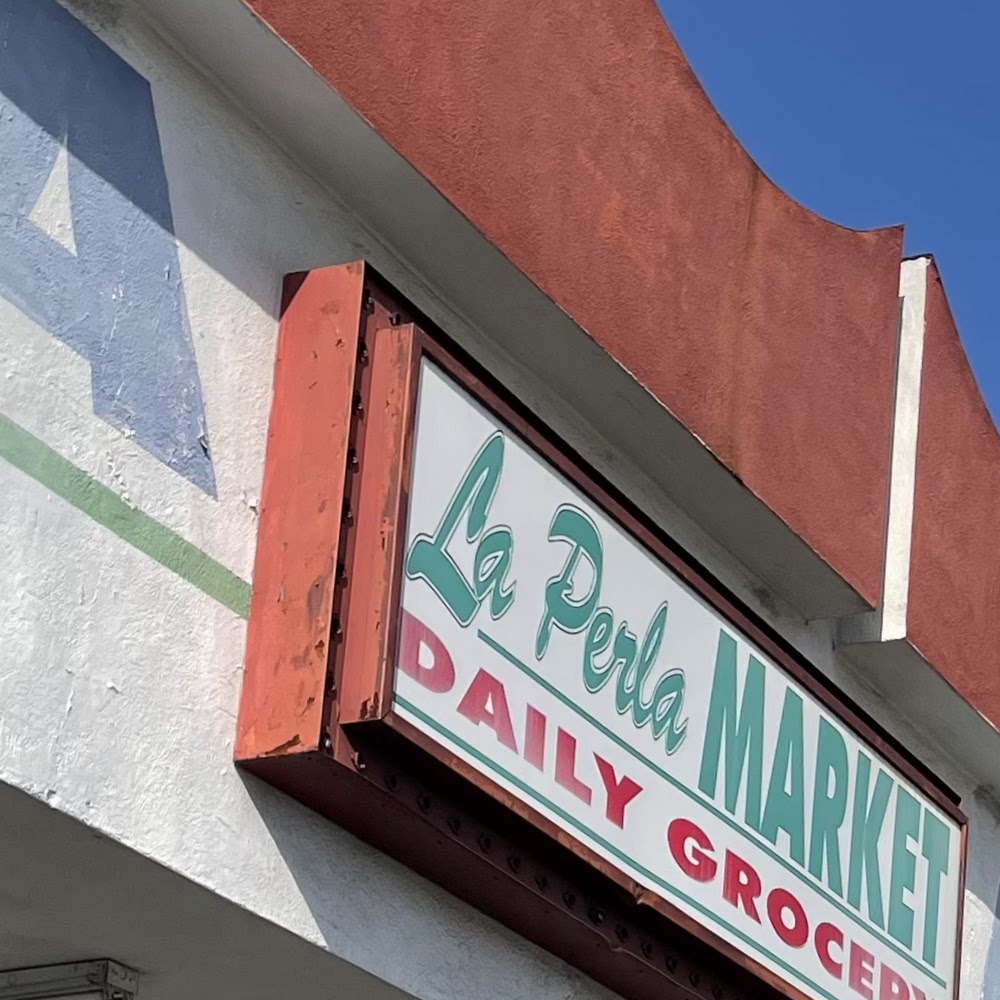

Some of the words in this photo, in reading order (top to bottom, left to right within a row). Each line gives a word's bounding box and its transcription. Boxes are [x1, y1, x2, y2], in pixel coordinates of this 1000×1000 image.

[400, 606, 644, 830] DAILY
[407, 431, 516, 627] La
[536, 503, 689, 755] Perla
[698, 628, 951, 969] MARKET
